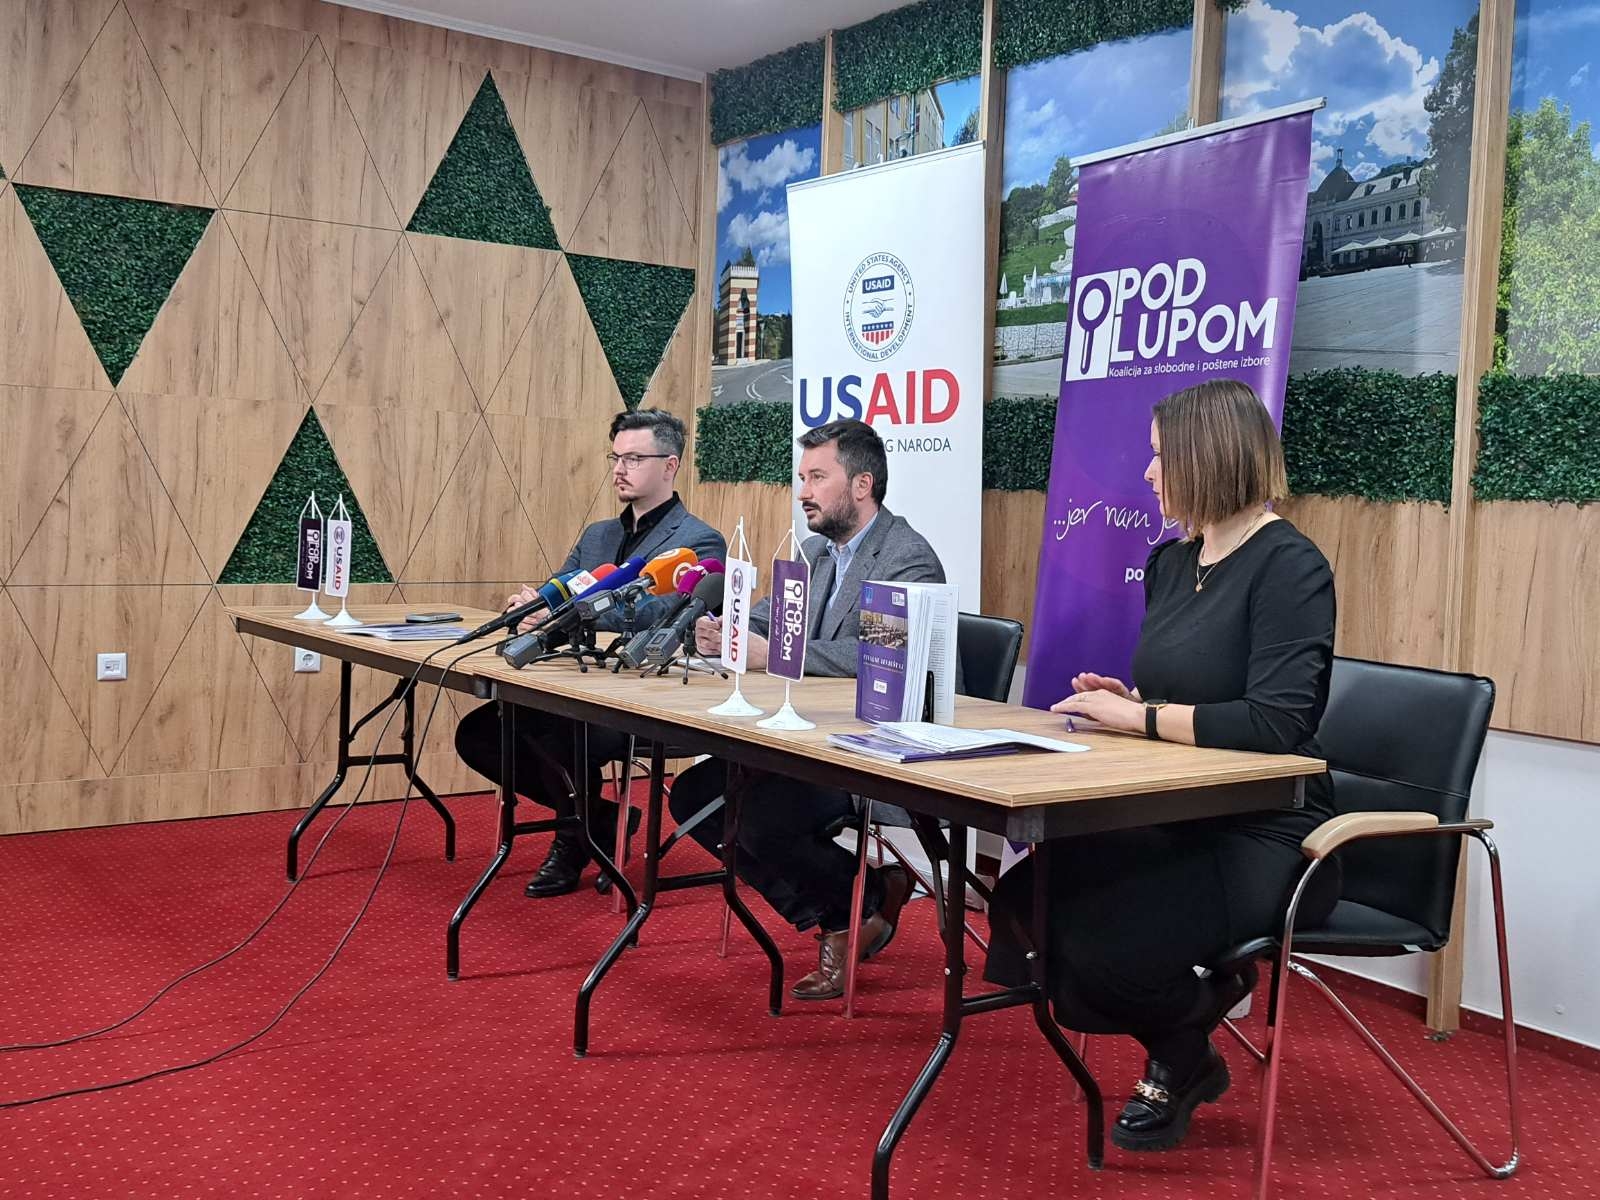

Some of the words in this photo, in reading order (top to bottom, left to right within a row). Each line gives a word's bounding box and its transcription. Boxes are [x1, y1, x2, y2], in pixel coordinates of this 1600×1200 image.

[848, 263, 867, 294] UNITED
[866, 254, 890, 267] STATES
[889, 258, 911, 287] AGENCY
[864, 277, 892, 292] USAID
[1115, 258, 1207, 315] POD
[844, 311, 879, 360] INTERNATIONAL
[880, 303, 914, 359] DEVELOPMENT
[1110, 297, 1278, 363] LUPOM
[1108, 366, 1142, 378] Koalicija
[1143, 366, 1153, 375] za
[1154, 359, 1195, 374] slobodne
[1202, 358, 1239, 371] poštene
[1240, 355, 1271, 369] izbore
[799, 369, 960, 428] USAID
[897, 437, 952, 452] NARODA
[1105, 505, 1151, 529] nam
[306, 541, 314, 579] LUPOM
[335, 546, 343, 590] USAID
[730, 598, 741, 663] USAID
[782, 599, 795, 661] LUPOM
[793, 600, 804, 636] POD
